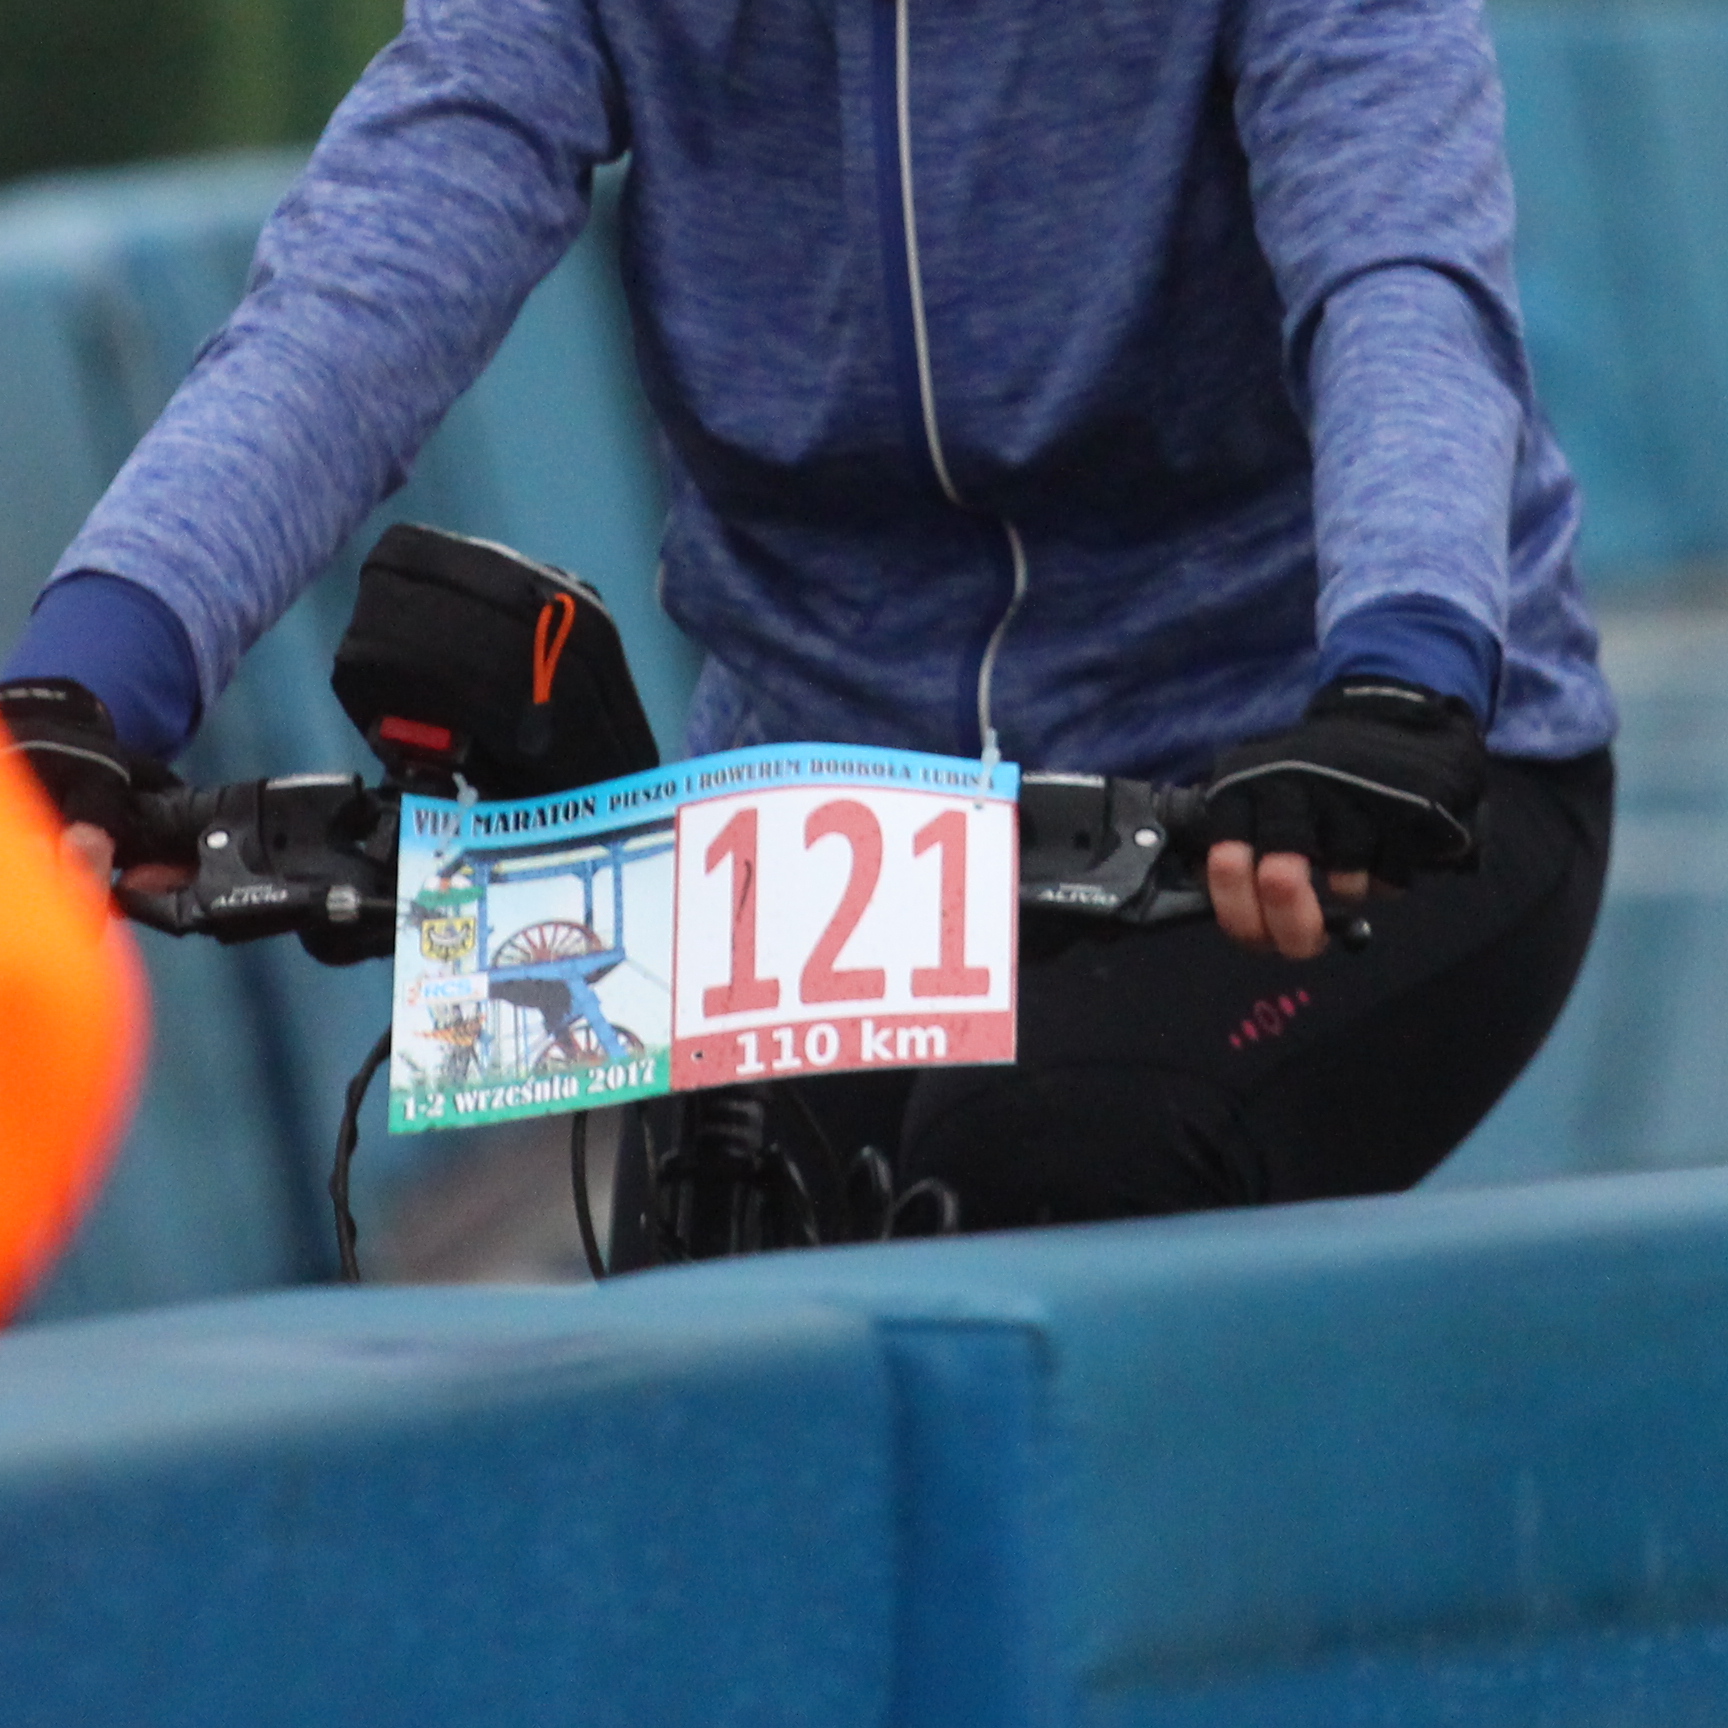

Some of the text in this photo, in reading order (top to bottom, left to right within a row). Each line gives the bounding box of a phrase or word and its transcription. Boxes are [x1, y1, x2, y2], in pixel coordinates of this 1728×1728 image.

[471, 796, 597, 838] MARATON
[607, 780, 676, 813] PIESZO
[697, 758, 801, 790] ROWEREM
[703, 800, 992, 1019] 121
[735, 1020, 948, 1075] 110 km
[403, 1059, 656, 1122] 1-2 września 2017
